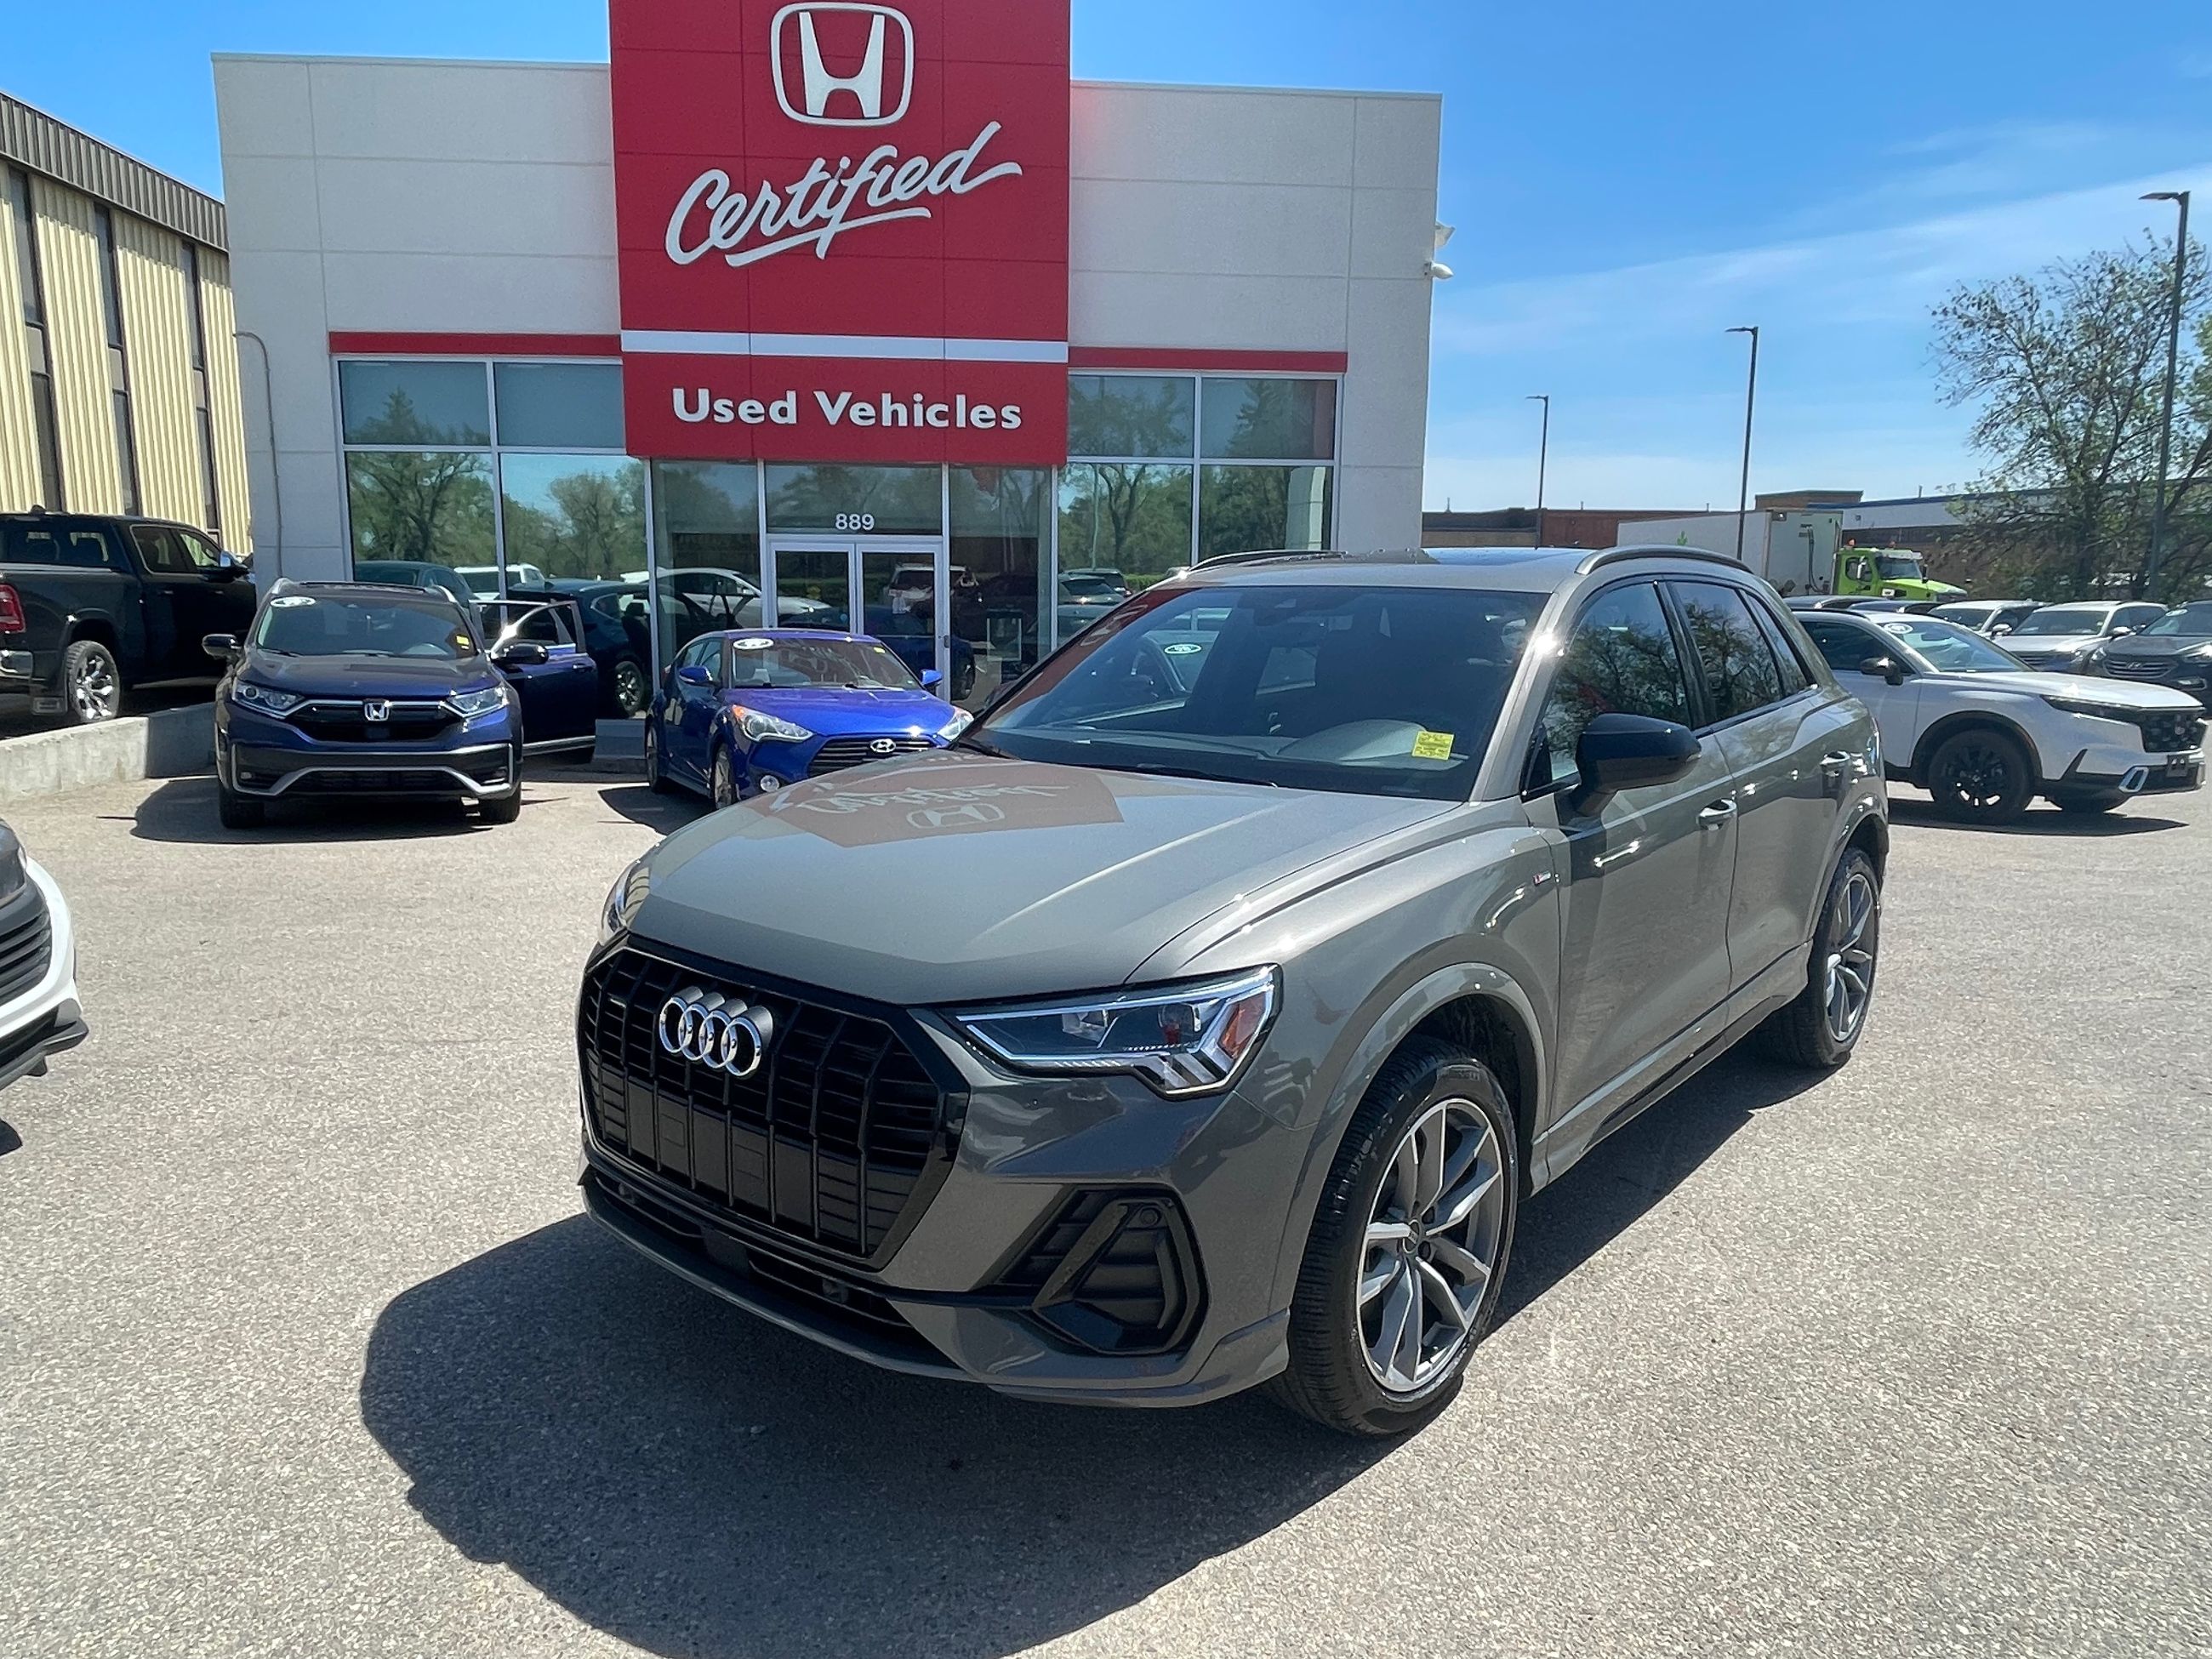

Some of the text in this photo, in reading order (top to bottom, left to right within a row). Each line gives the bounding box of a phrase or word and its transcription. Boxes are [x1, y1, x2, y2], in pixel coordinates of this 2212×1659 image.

[665, 121, 1023, 267] Certified
[672, 388, 1022, 429] Used Vehicles
[835, 513, 875, 531] 889
